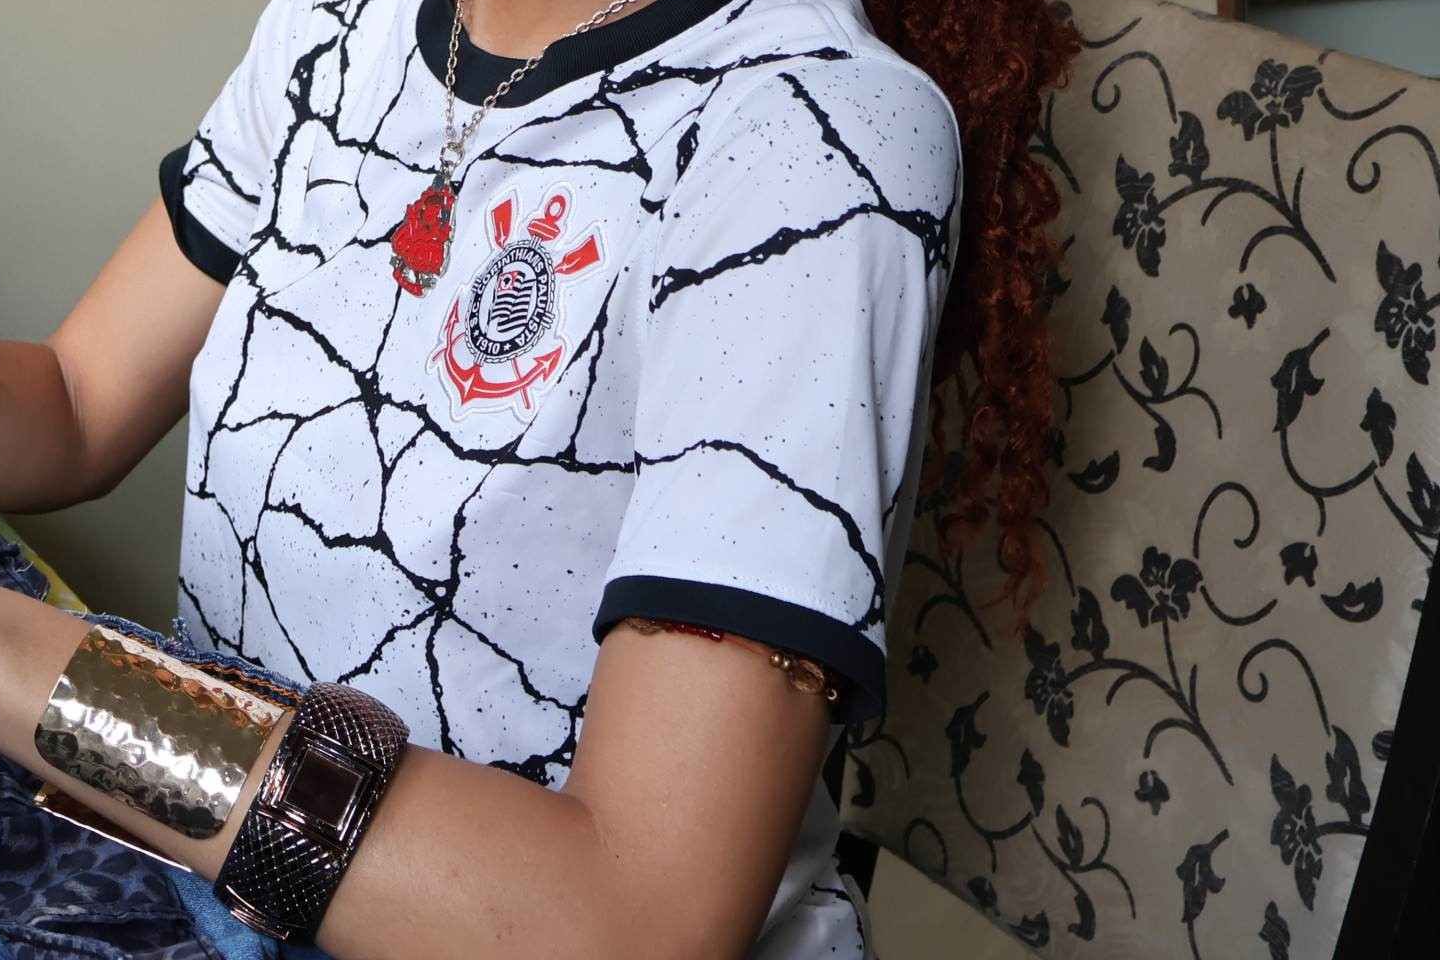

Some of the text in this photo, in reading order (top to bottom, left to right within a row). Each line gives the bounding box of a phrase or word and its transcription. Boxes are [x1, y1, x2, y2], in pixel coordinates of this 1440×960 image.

[477, 248, 544, 295] CORINTHIANS
[514, 273, 548, 347] PAULISTA
[476, 337, 501, 355] 1910
